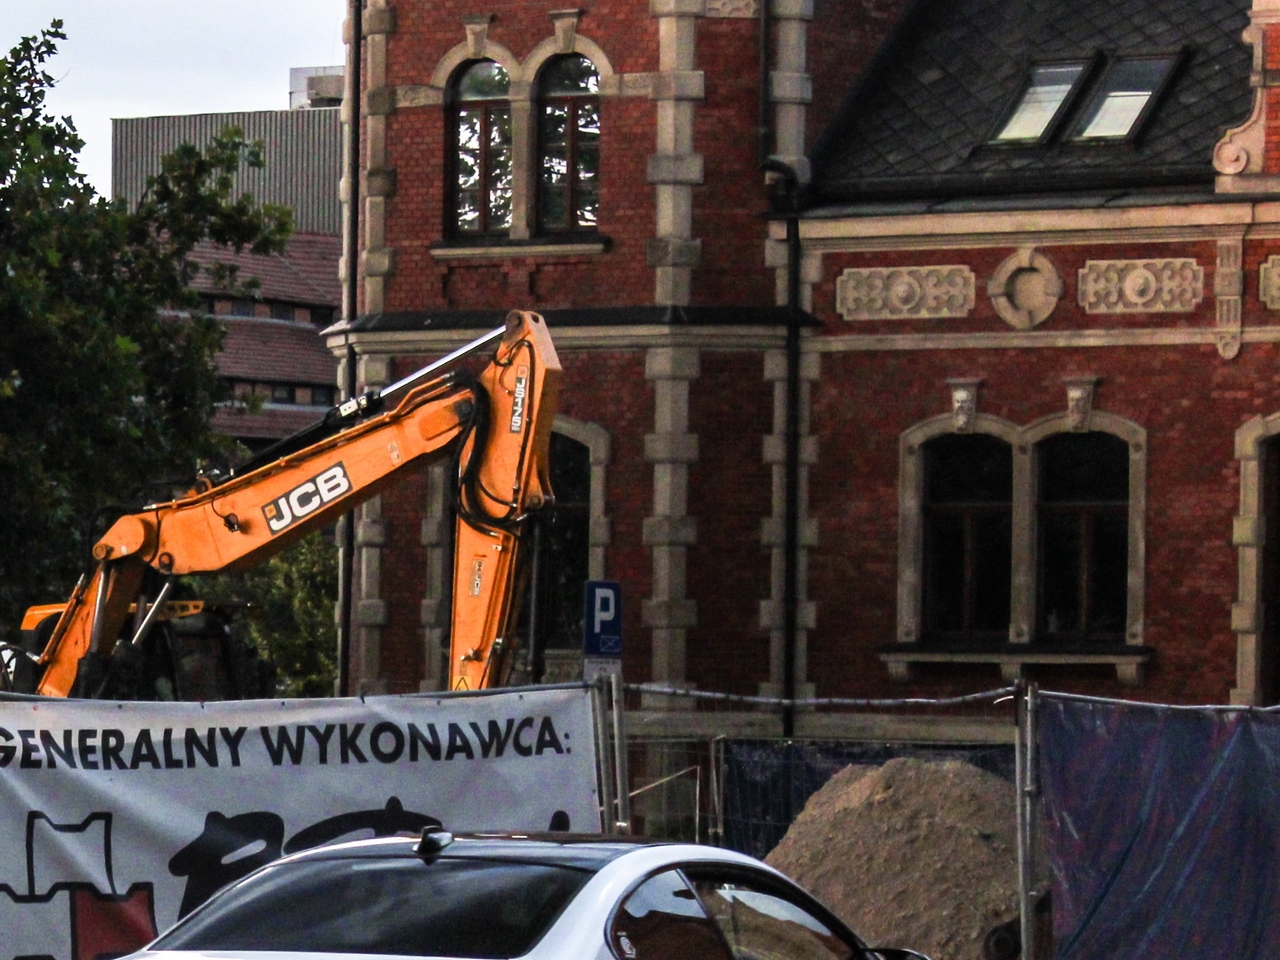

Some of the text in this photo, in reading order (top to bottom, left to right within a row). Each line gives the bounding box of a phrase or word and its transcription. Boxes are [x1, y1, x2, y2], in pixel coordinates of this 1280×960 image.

[269, 466, 349, 531] JCB
[594, 588, 615, 634] P
[260, 715, 572, 767] WYKONAWCA:
